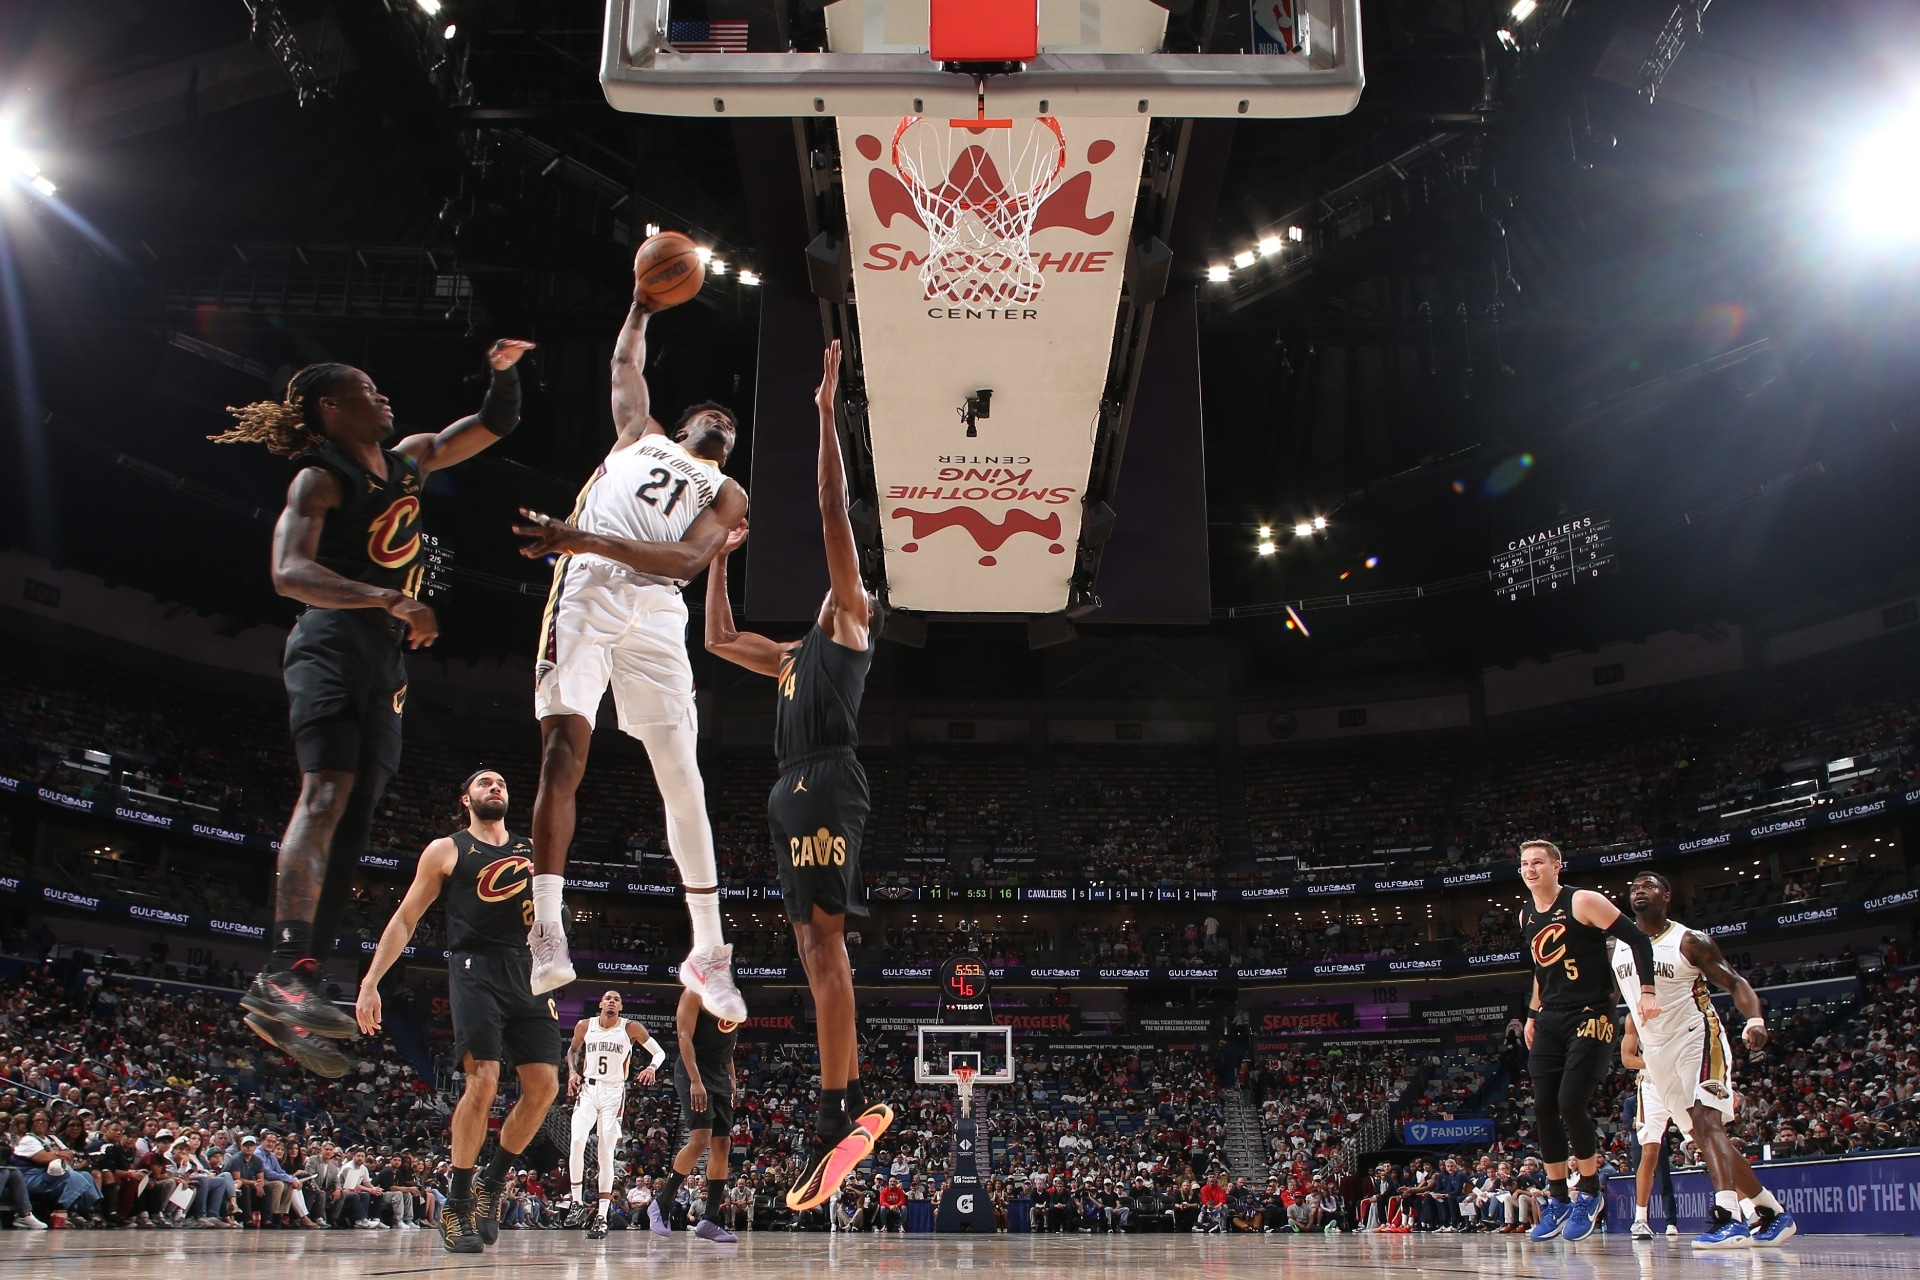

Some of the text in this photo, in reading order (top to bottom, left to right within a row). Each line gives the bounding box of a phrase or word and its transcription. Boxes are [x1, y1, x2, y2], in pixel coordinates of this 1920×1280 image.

[1258, 43, 1280, 55] NBA
[862, 243, 1113, 274] SMOOTHIE
[928, 308, 1037, 320] CENTER
[938, 456, 1030, 464] CENTER
[634, 446, 713, 508] NEW ORLEANS
[635, 468, 689, 518] 21
[885, 486, 1077, 504] SMOOTHIE
[1508, 517, 1592, 551] CAVALIERS
[1585, 534, 1599, 544] 2/5
[1544, 546, 1558, 556] 2/2
[1590, 551, 1596, 560] 5
[429, 554, 442, 564] 2/5
[1500, 557, 1524, 571] 54.5%
[1550, 564, 1556, 572] 5
[1592, 569, 1598, 577] 0
[1508, 577, 1514, 585] 0
[1552, 582, 1557, 590] 0
[1510, 593, 1516, 601] 8
[38, 788, 94, 809] GULFCOAST
[116, 807, 172, 826] GULFCOAST
[1828, 801, 1886, 820] GULFCOAST
[193, 824, 246, 842] GULFCOAST
[1751, 818, 1806, 836] GULFCOAST
[790, 828, 846, 867] CAVS
[1679, 834, 1730, 850] GULFCOAST
[360, 856, 399, 867] LFCOAST
[1600, 850, 1654, 864] GULFCOAST
[477, 855, 531, 902] C
[1374, 880, 1424, 890] GULFCOAST
[1443, 872, 1492, 884] GULFCOAST
[628, 883, 676, 893] GULFCOAST
[930, 890, 941, 898] 11
[967, 889, 986, 898] 5:53
[1000, 889, 1012, 898] 16
[1027, 890, 1067, 898] CAVALIERS
[1242, 888, 1289, 897] GULFCOAST
[1307, 884, 1356, 893] GULFCOAST
[44, 888, 99, 907] GULFCOAST
[1864, 889, 1918, 909] GULFCOAST
[130, 905, 189, 923] GULFCOAST
[522, 900, 533, 926] 2
[1778, 908, 1838, 924] GULFCOAST
[210, 920, 266, 936] GULFCOAST
[1531, 923, 1567, 968] C
[186, 946, 212, 966] 104
[1469, 952, 1520, 964] GULFCOAST
[598, 962, 649, 972] GULFCOAST
[956, 965, 980, 975] 5:53
[1314, 964, 1366, 974] GULFCOAST
[1389, 960, 1442, 970] GULFCOAST
[1564, 959, 1579, 981] 5
[1616, 962, 1674, 979] NEW EANS
[1237, 968, 1288, 977] GULFCOAST
[951, 976, 973, 996] 4.6
[1371, 987, 1398, 1003] 108
[738, 1016, 795, 1029] ATGEEK
[994, 1014, 1070, 1029] SEATGEEK
[1264, 1012, 1340, 1030] SEATGEEK
[1576, 1016, 1614, 1044] CAVS
[1455, 1034, 1488, 1042] SEATGEEK
[587, 1042, 624, 1054] NEW ORLEANS
[598, 1056, 607, 1075] 5
[1778, 1185, 1844, 1214] PARTNER
[1847, 1184, 1867, 1212] OF
[1870, 1183, 1905, 1212] THE
